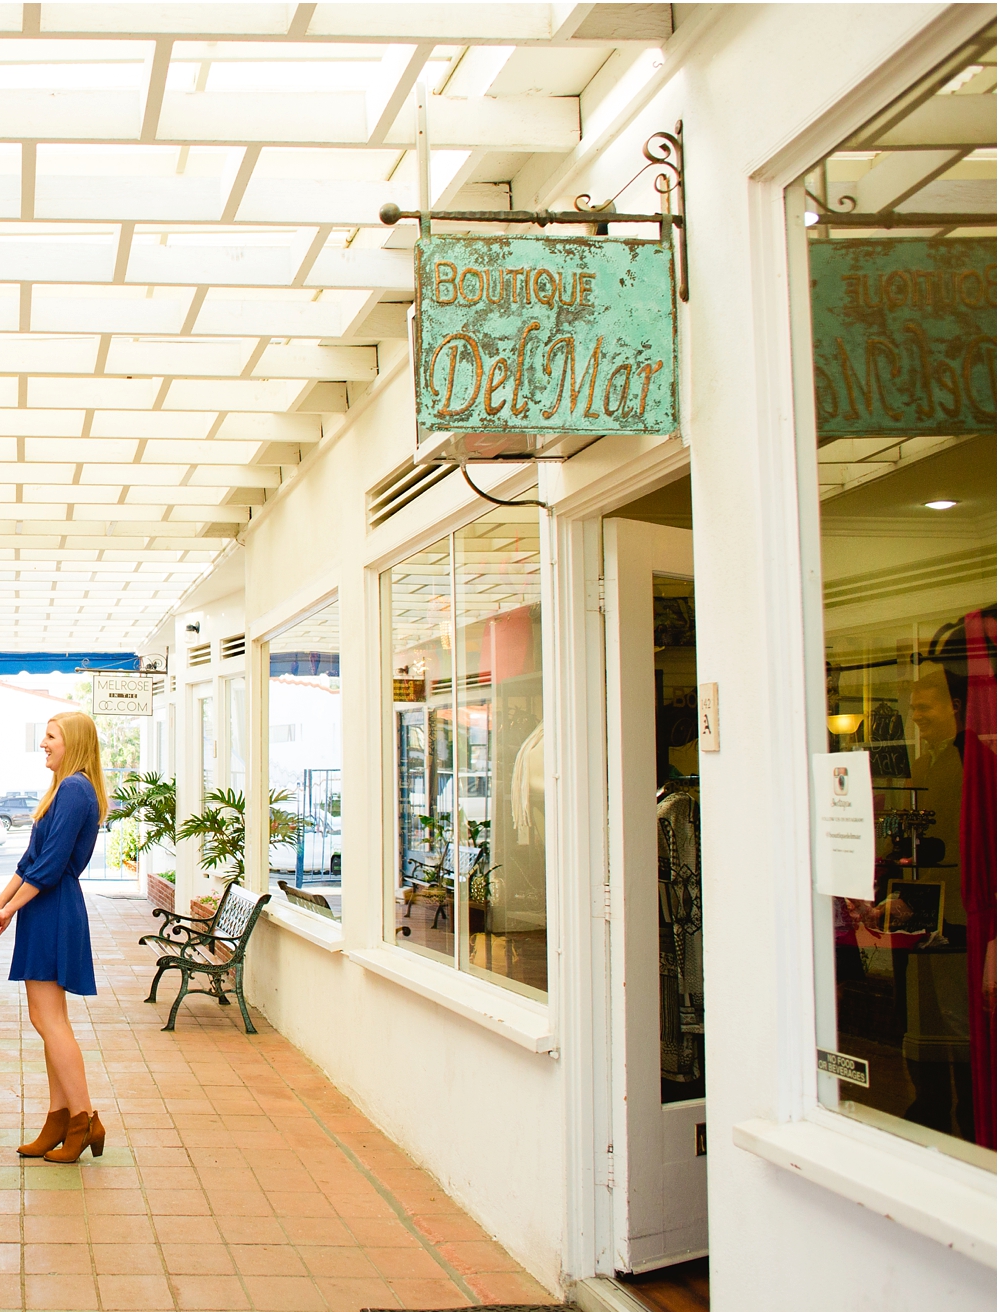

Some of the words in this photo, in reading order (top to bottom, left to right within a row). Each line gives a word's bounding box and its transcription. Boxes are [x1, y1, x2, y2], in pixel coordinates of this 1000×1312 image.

[434, 260, 597, 310] BOUTIQUE
[430, 321, 541, 418] Del
[542, 336, 663, 419] Mar
[98, 680, 149, 691] MELROSE
[98, 700, 148, 712] OC.COM
[818, 1060, 827, 1070] OR
[828, 1062, 865, 1082] BEVERAGES
[827, 1054, 836, 1064] NO
[837, 1056, 855, 1070] FOOD
